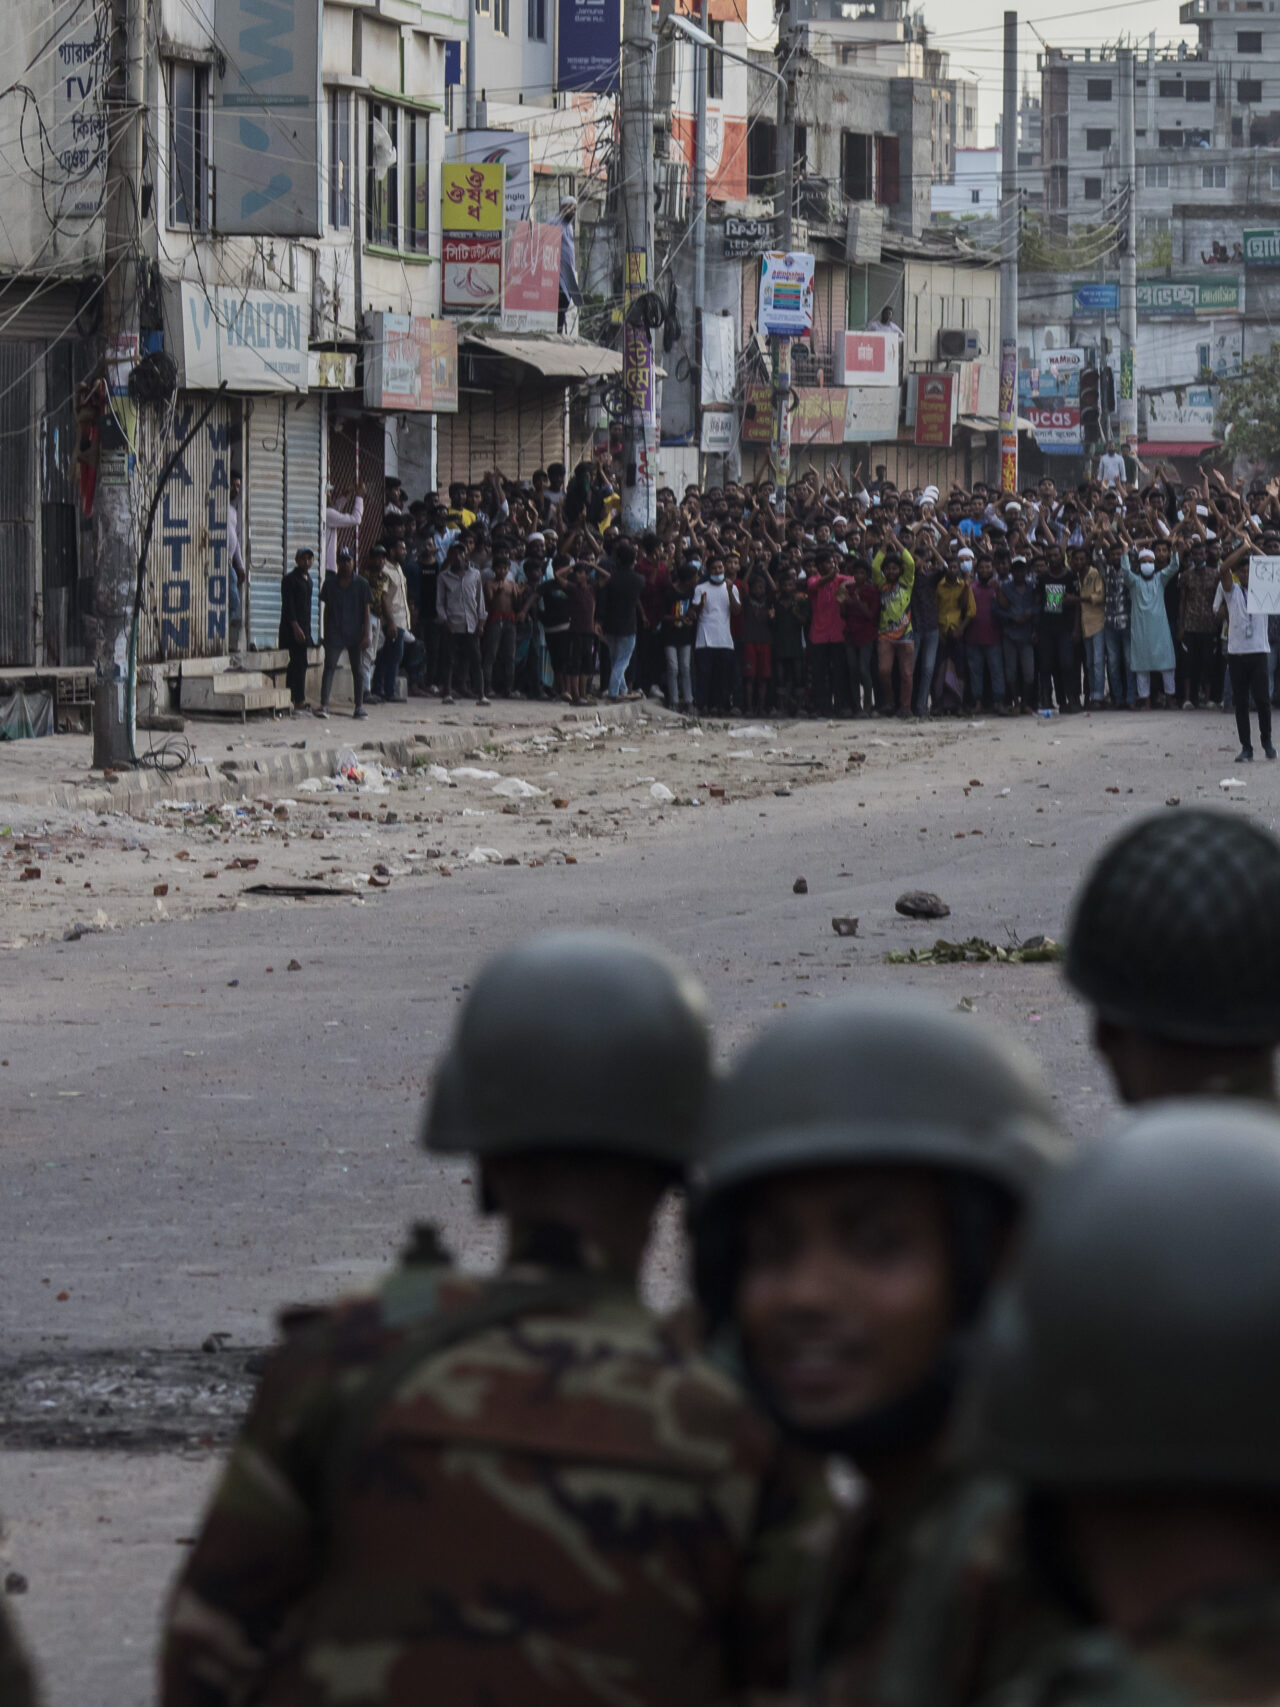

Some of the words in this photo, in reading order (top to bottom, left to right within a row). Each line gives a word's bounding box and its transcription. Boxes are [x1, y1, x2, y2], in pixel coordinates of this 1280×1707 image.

[62, 76, 93, 101] TV
[446, 243, 469, 261] সিটি
[223, 298, 300, 351] WALTON
[160, 404, 193, 649] WALTON
[207, 423, 229, 640] WALTON
